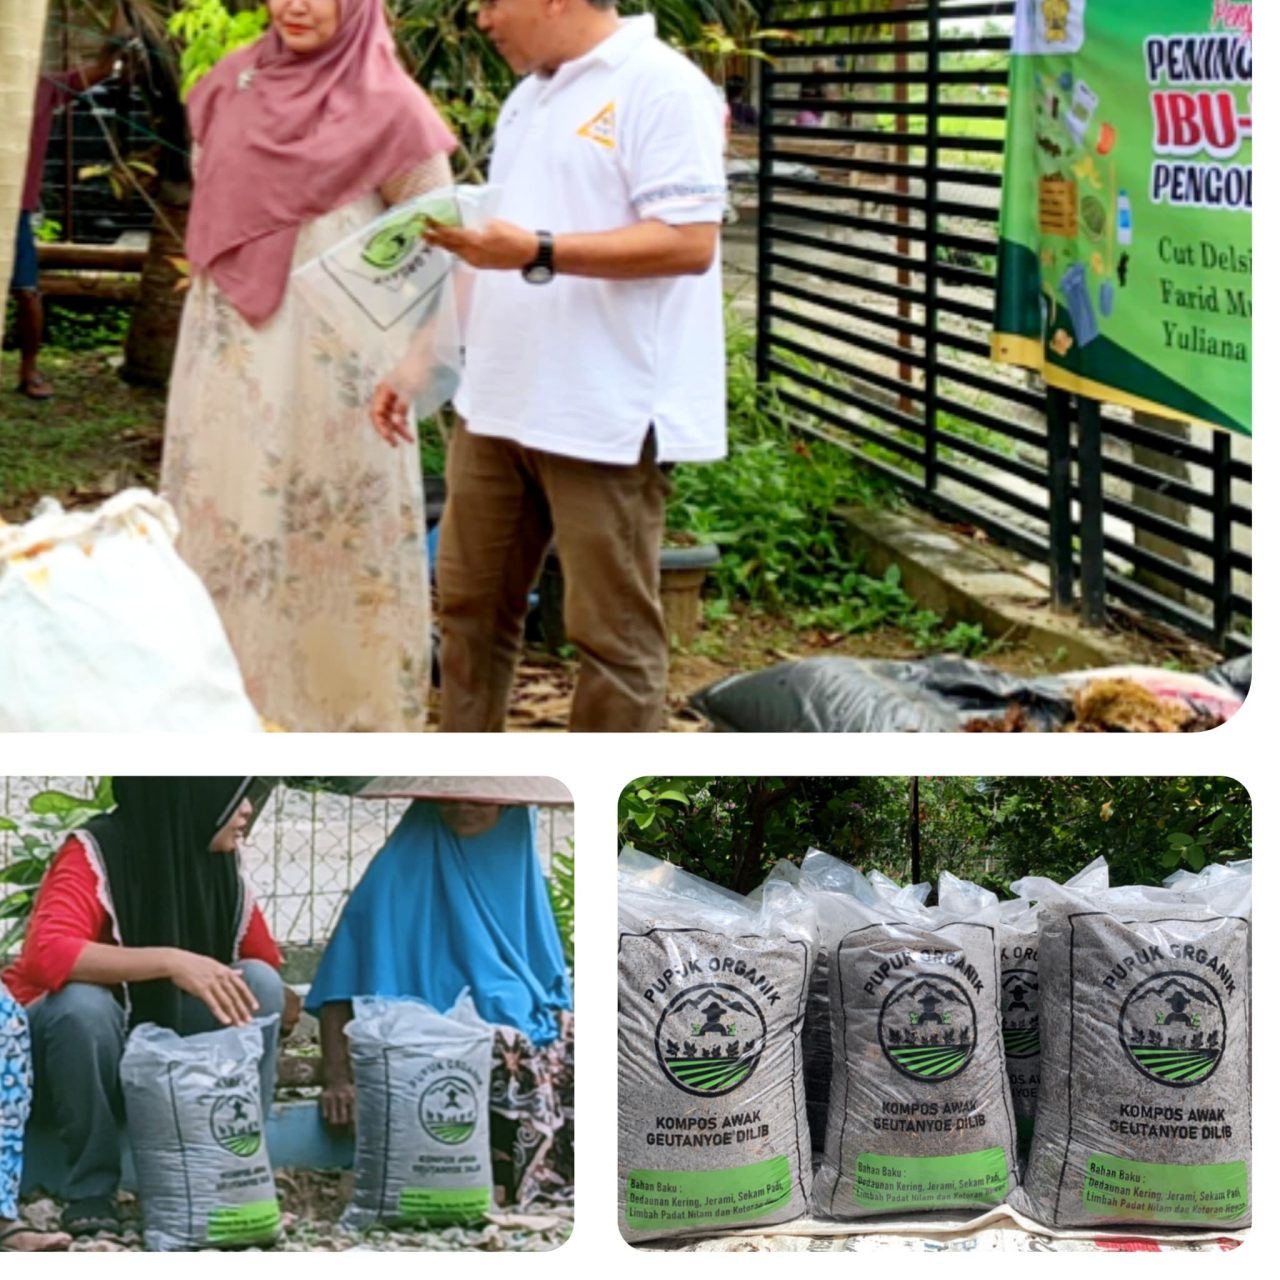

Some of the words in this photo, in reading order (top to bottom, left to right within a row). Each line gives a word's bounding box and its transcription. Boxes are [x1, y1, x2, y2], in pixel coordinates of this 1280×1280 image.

[1158, 235, 1195, 267] Cut
[1160, 277, 1220, 313] Farid
[1162, 320, 1248, 363] Yuliana
[864, 951, 916, 996] PUPUK
[920, 949, 984, 996] ORGANIK
[1103, 946, 1164, 991] PUPUK
[709, 957, 781, 1006] ORGANIK
[882, 1101, 939, 1116] KOMPOS
[942, 1100, 977, 1114] AWAK
[1120, 1104, 1183, 1122] KOMPOS
[1188, 1108, 1226, 1122] AWAK
[656, 1116, 718, 1131] KOMPOS
[722, 1110, 761, 1129] AWAK
[873, 1116, 952, 1132] GEUTANYOE
[956, 1114, 986, 1130] DILIB
[1109, 1120, 1198, 1140] GEUTANYOE
[1202, 1125, 1232, 1140] DILIB
[646, 1131, 732, 1147] GEUTANYOE
[736, 1124, 770, 1144] DILIB
[882, 1166, 902, 1178] Baku
[1090, 1162, 1117, 1178] Bahan
[1119, 1169, 1141, 1183] Baku
[630, 1178, 655, 1192] Bahan
[657, 1181, 677, 1193] Baku
[958, 1177, 984, 1189] Sekam
[1088, 1177, 1131, 1195] Dedaunan
[1167, 1190, 1197, 1203] Jerami,
[1200, 1188, 1225, 1201] Sekam
[630, 1193, 670, 1206] Dedaunan
[704, 1194, 736, 1206] Jerami,
[738, 1188, 765, 1201] Sekam
[886, 1190, 909, 1202] Padat
[936, 1190, 952, 1201] dan
[1086, 1191, 1118, 1207] Limbah
[1120, 1199, 1145, 1211] Padat
[1147, 1202, 1172, 1214] Nilam
[629, 1207, 659, 1220] Limbah
[661, 1208, 686, 1220] Padat
[688, 1207, 713, 1219] Nilam
[715, 1207, 731, 1217] dan
